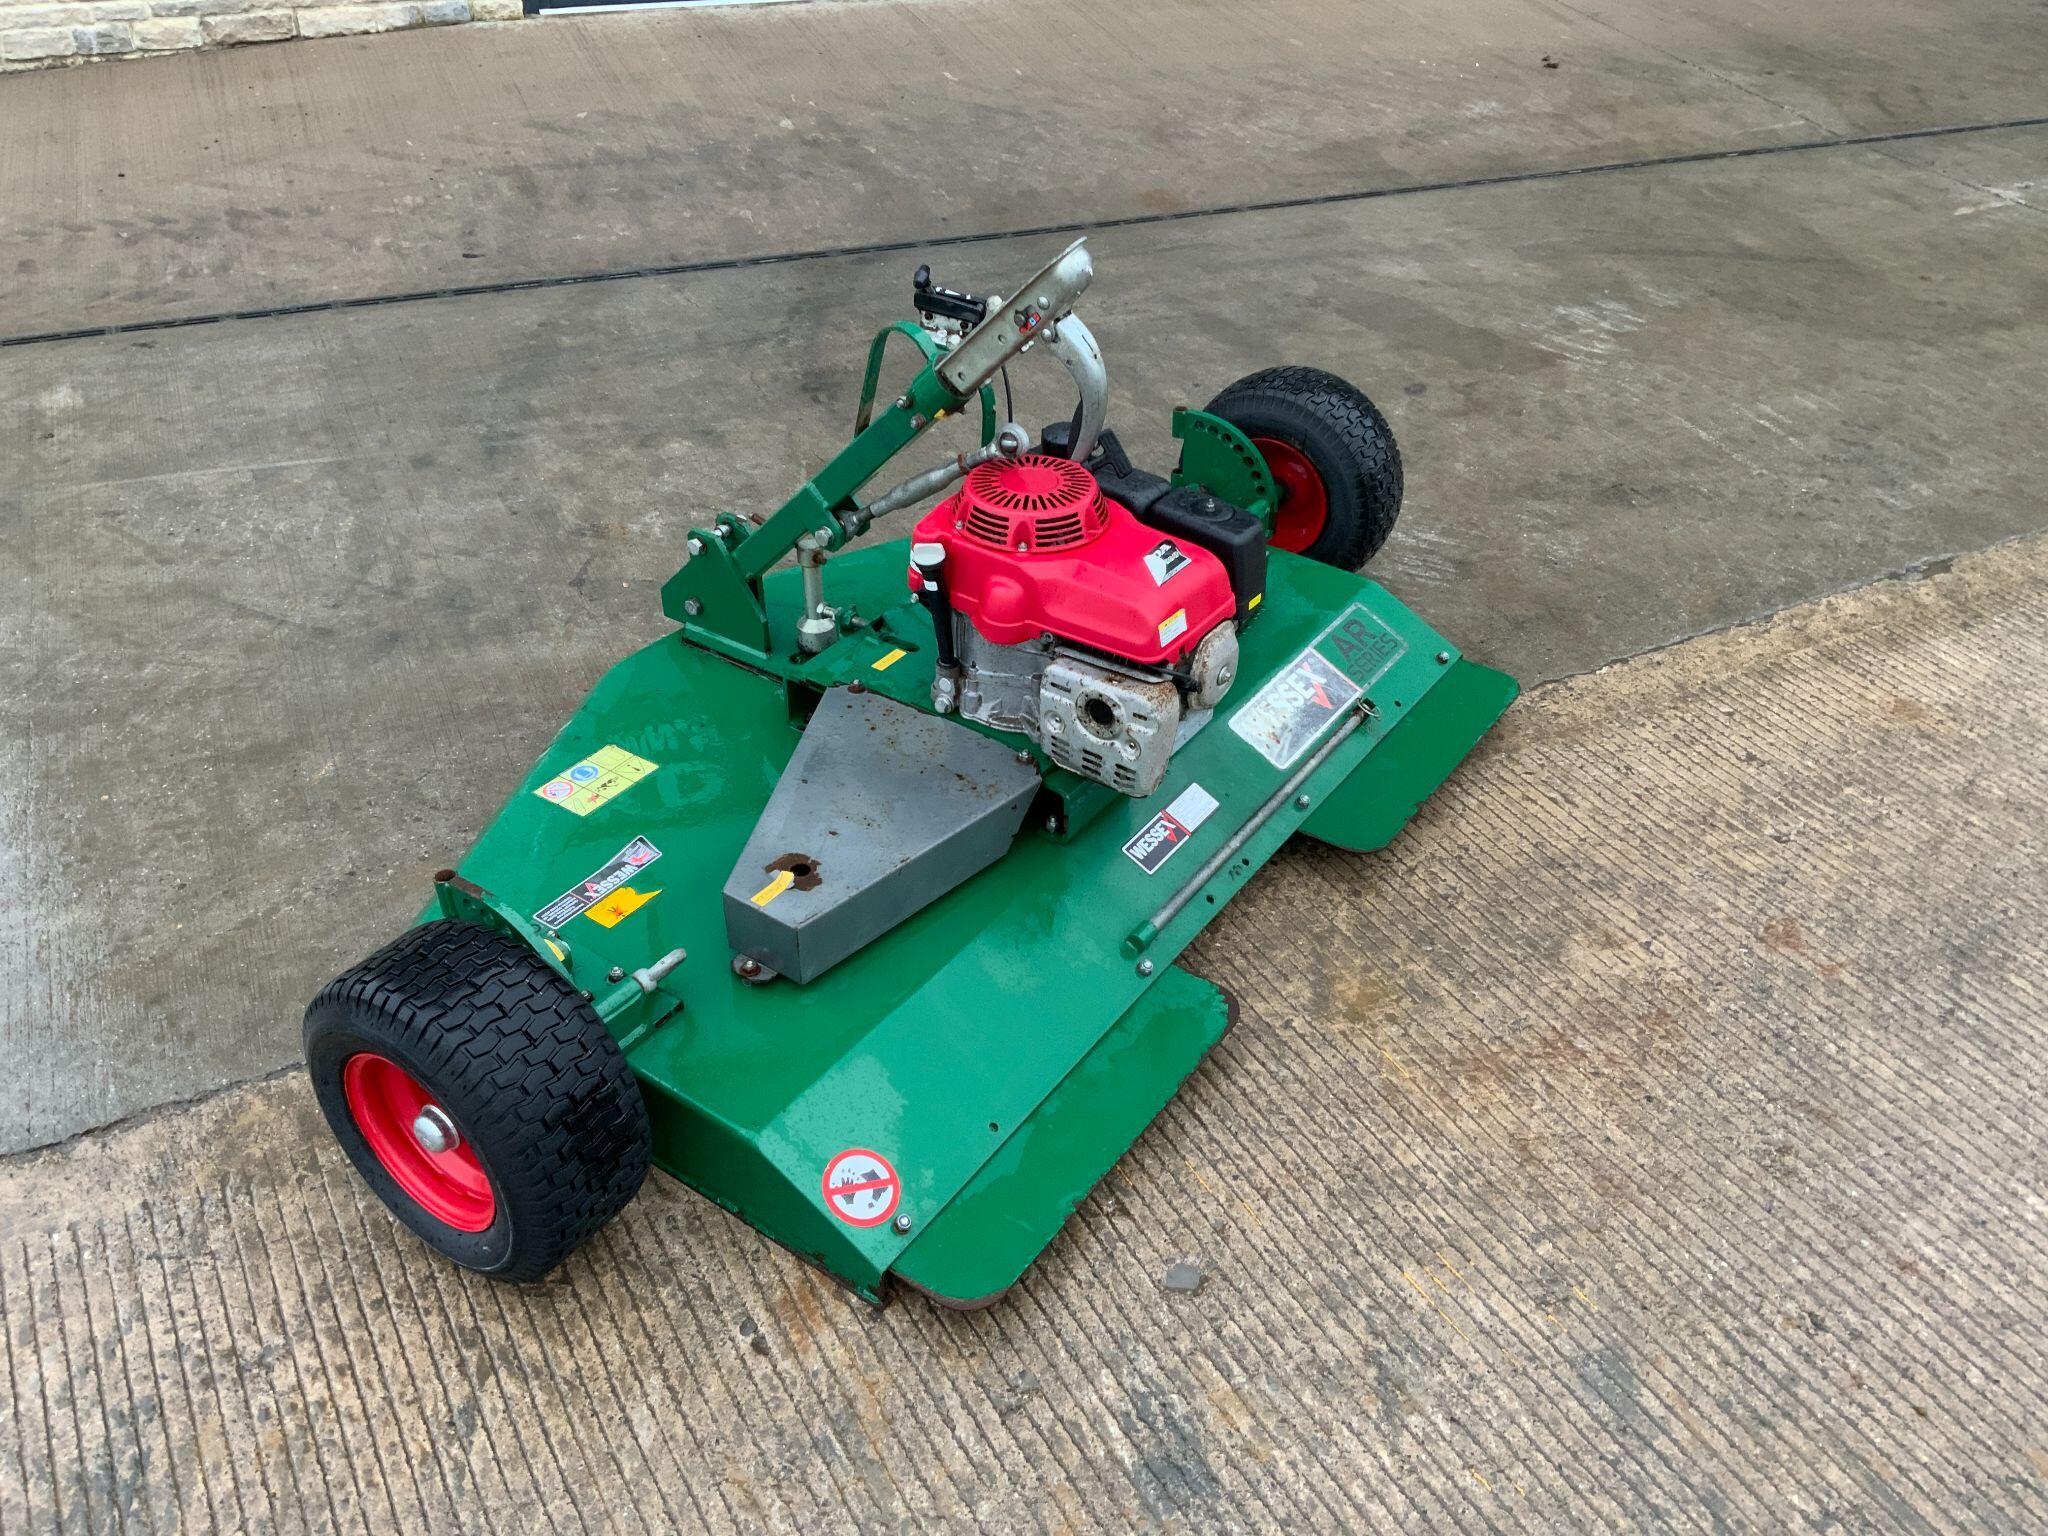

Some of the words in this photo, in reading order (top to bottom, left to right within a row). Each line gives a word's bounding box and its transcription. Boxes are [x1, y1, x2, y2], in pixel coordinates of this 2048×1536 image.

[1331, 618, 1376, 664] AR
[1349, 632, 1398, 681] SERIES
[1242, 662, 1333, 737] ESSEX
[1129, 816, 1177, 860] WESSEX
[584, 864, 638, 900] WESSEX
